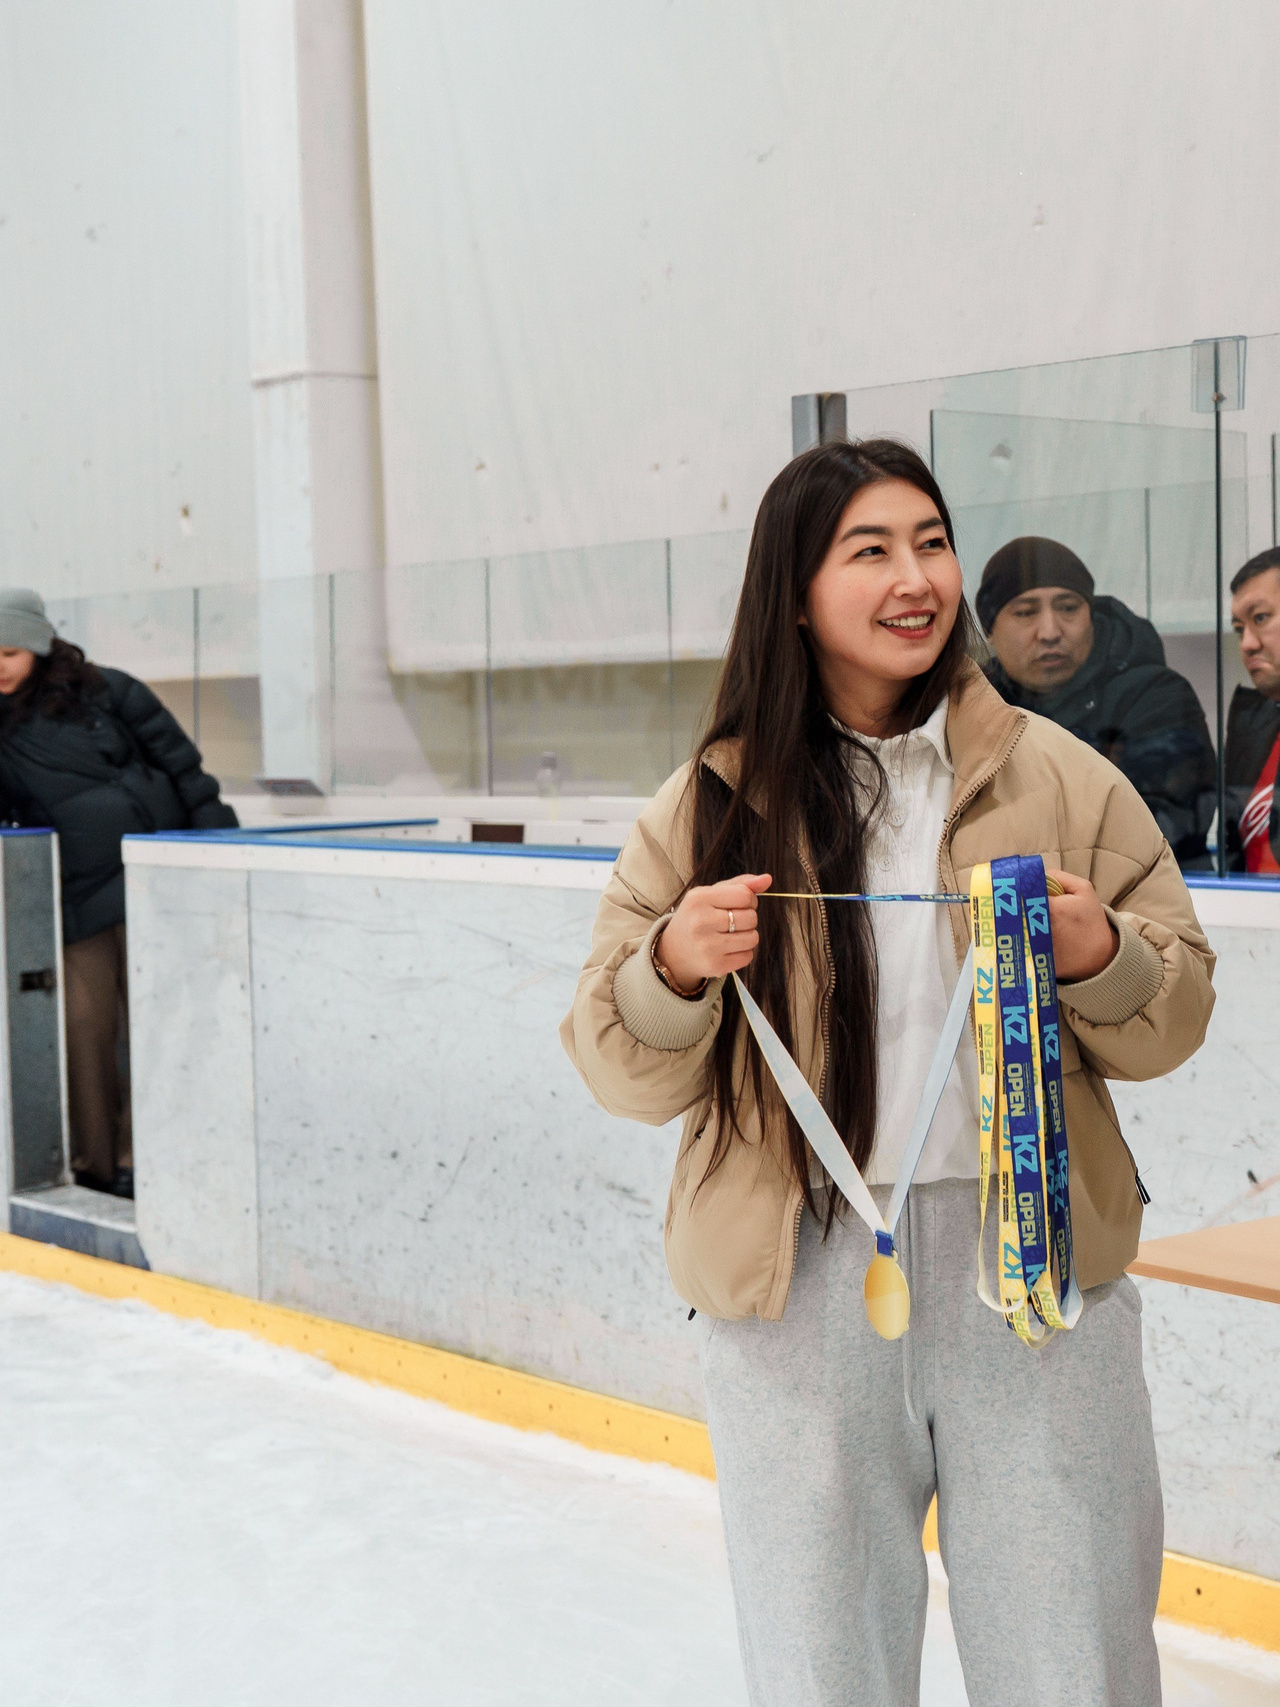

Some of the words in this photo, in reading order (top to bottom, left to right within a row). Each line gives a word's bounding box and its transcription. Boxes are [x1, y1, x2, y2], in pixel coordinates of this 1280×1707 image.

[993, 877, 1018, 917] KZ
[1026, 896, 1050, 937] KZ
[980, 895, 994, 948] OPEN
[997, 934, 1016, 989] OPEN
[1034, 953, 1051, 1008] OPEN
[976, 967, 994, 1004] KZ
[1003, 1005, 1028, 1046] KZ
[1043, 1023, 1060, 1063] KZ
[980, 1023, 994, 1076] OPEN
[1007, 1063, 1026, 1118] OPEN
[1049, 1080, 1062, 1135] OPEN
[981, 1095, 994, 1132] KZ
[1013, 1134, 1039, 1175] KZ
[1057, 1149, 1068, 1189] KZ
[1018, 1191, 1037, 1247] OPEN
[1003, 1242, 1023, 1280] KZ
[1056, 1228, 1067, 1282] OPEN
